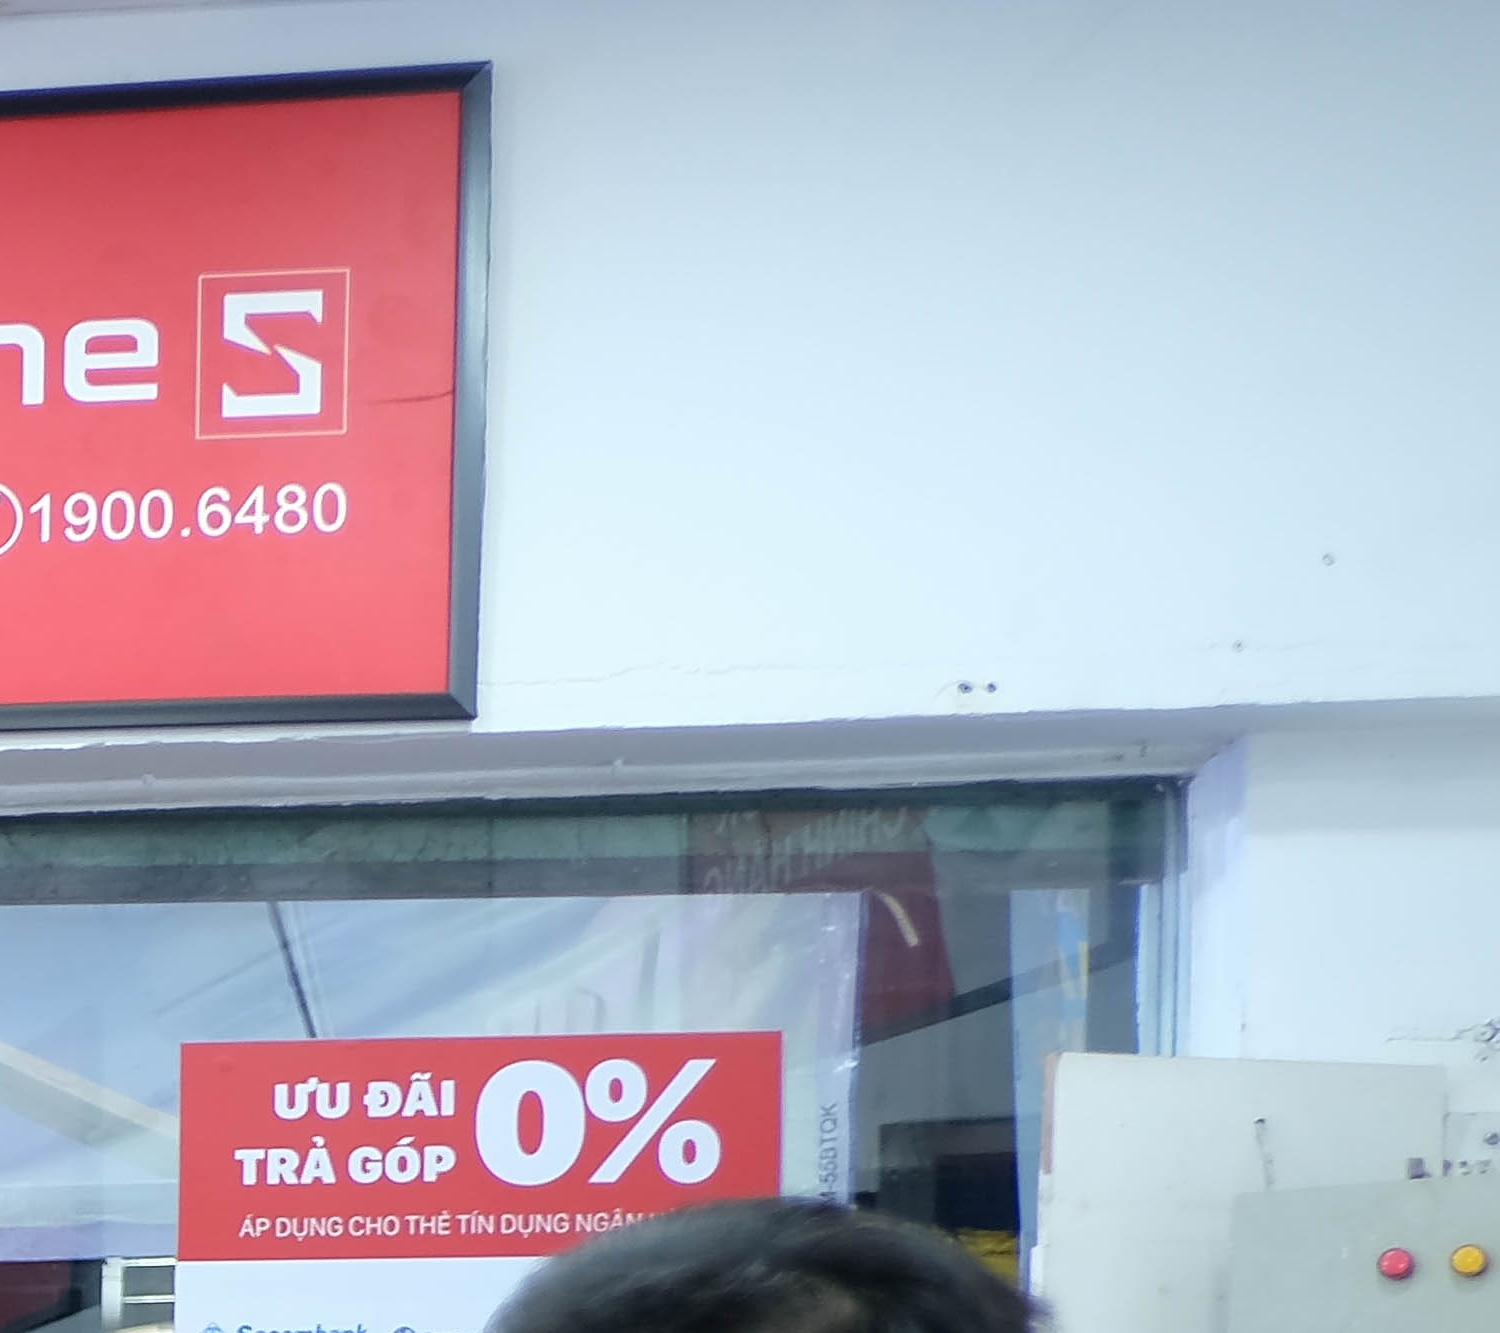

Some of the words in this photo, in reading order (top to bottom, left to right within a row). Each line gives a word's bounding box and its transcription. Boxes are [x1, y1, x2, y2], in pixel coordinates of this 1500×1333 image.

[28, 481, 349, 545] 1900.6480
[273, 1081, 350, 1121] ƯU
[363, 1069, 455, 1119] ĐÃI
[474, 1057, 720, 1187] 0%
[235, 1130, 338, 1185] TRẢ
[348, 1127, 456, 1183] GÓP
[239, 1214, 270, 1238] ÁP
[275, 1217, 343, 1243] DỤNG
[348, 1216, 400, 1236] CHO
[404, 1210, 451, 1236] THẺ
[456, 1211, 495, 1235] TÍN
[500, 1213, 570, 1239] DỤNG
